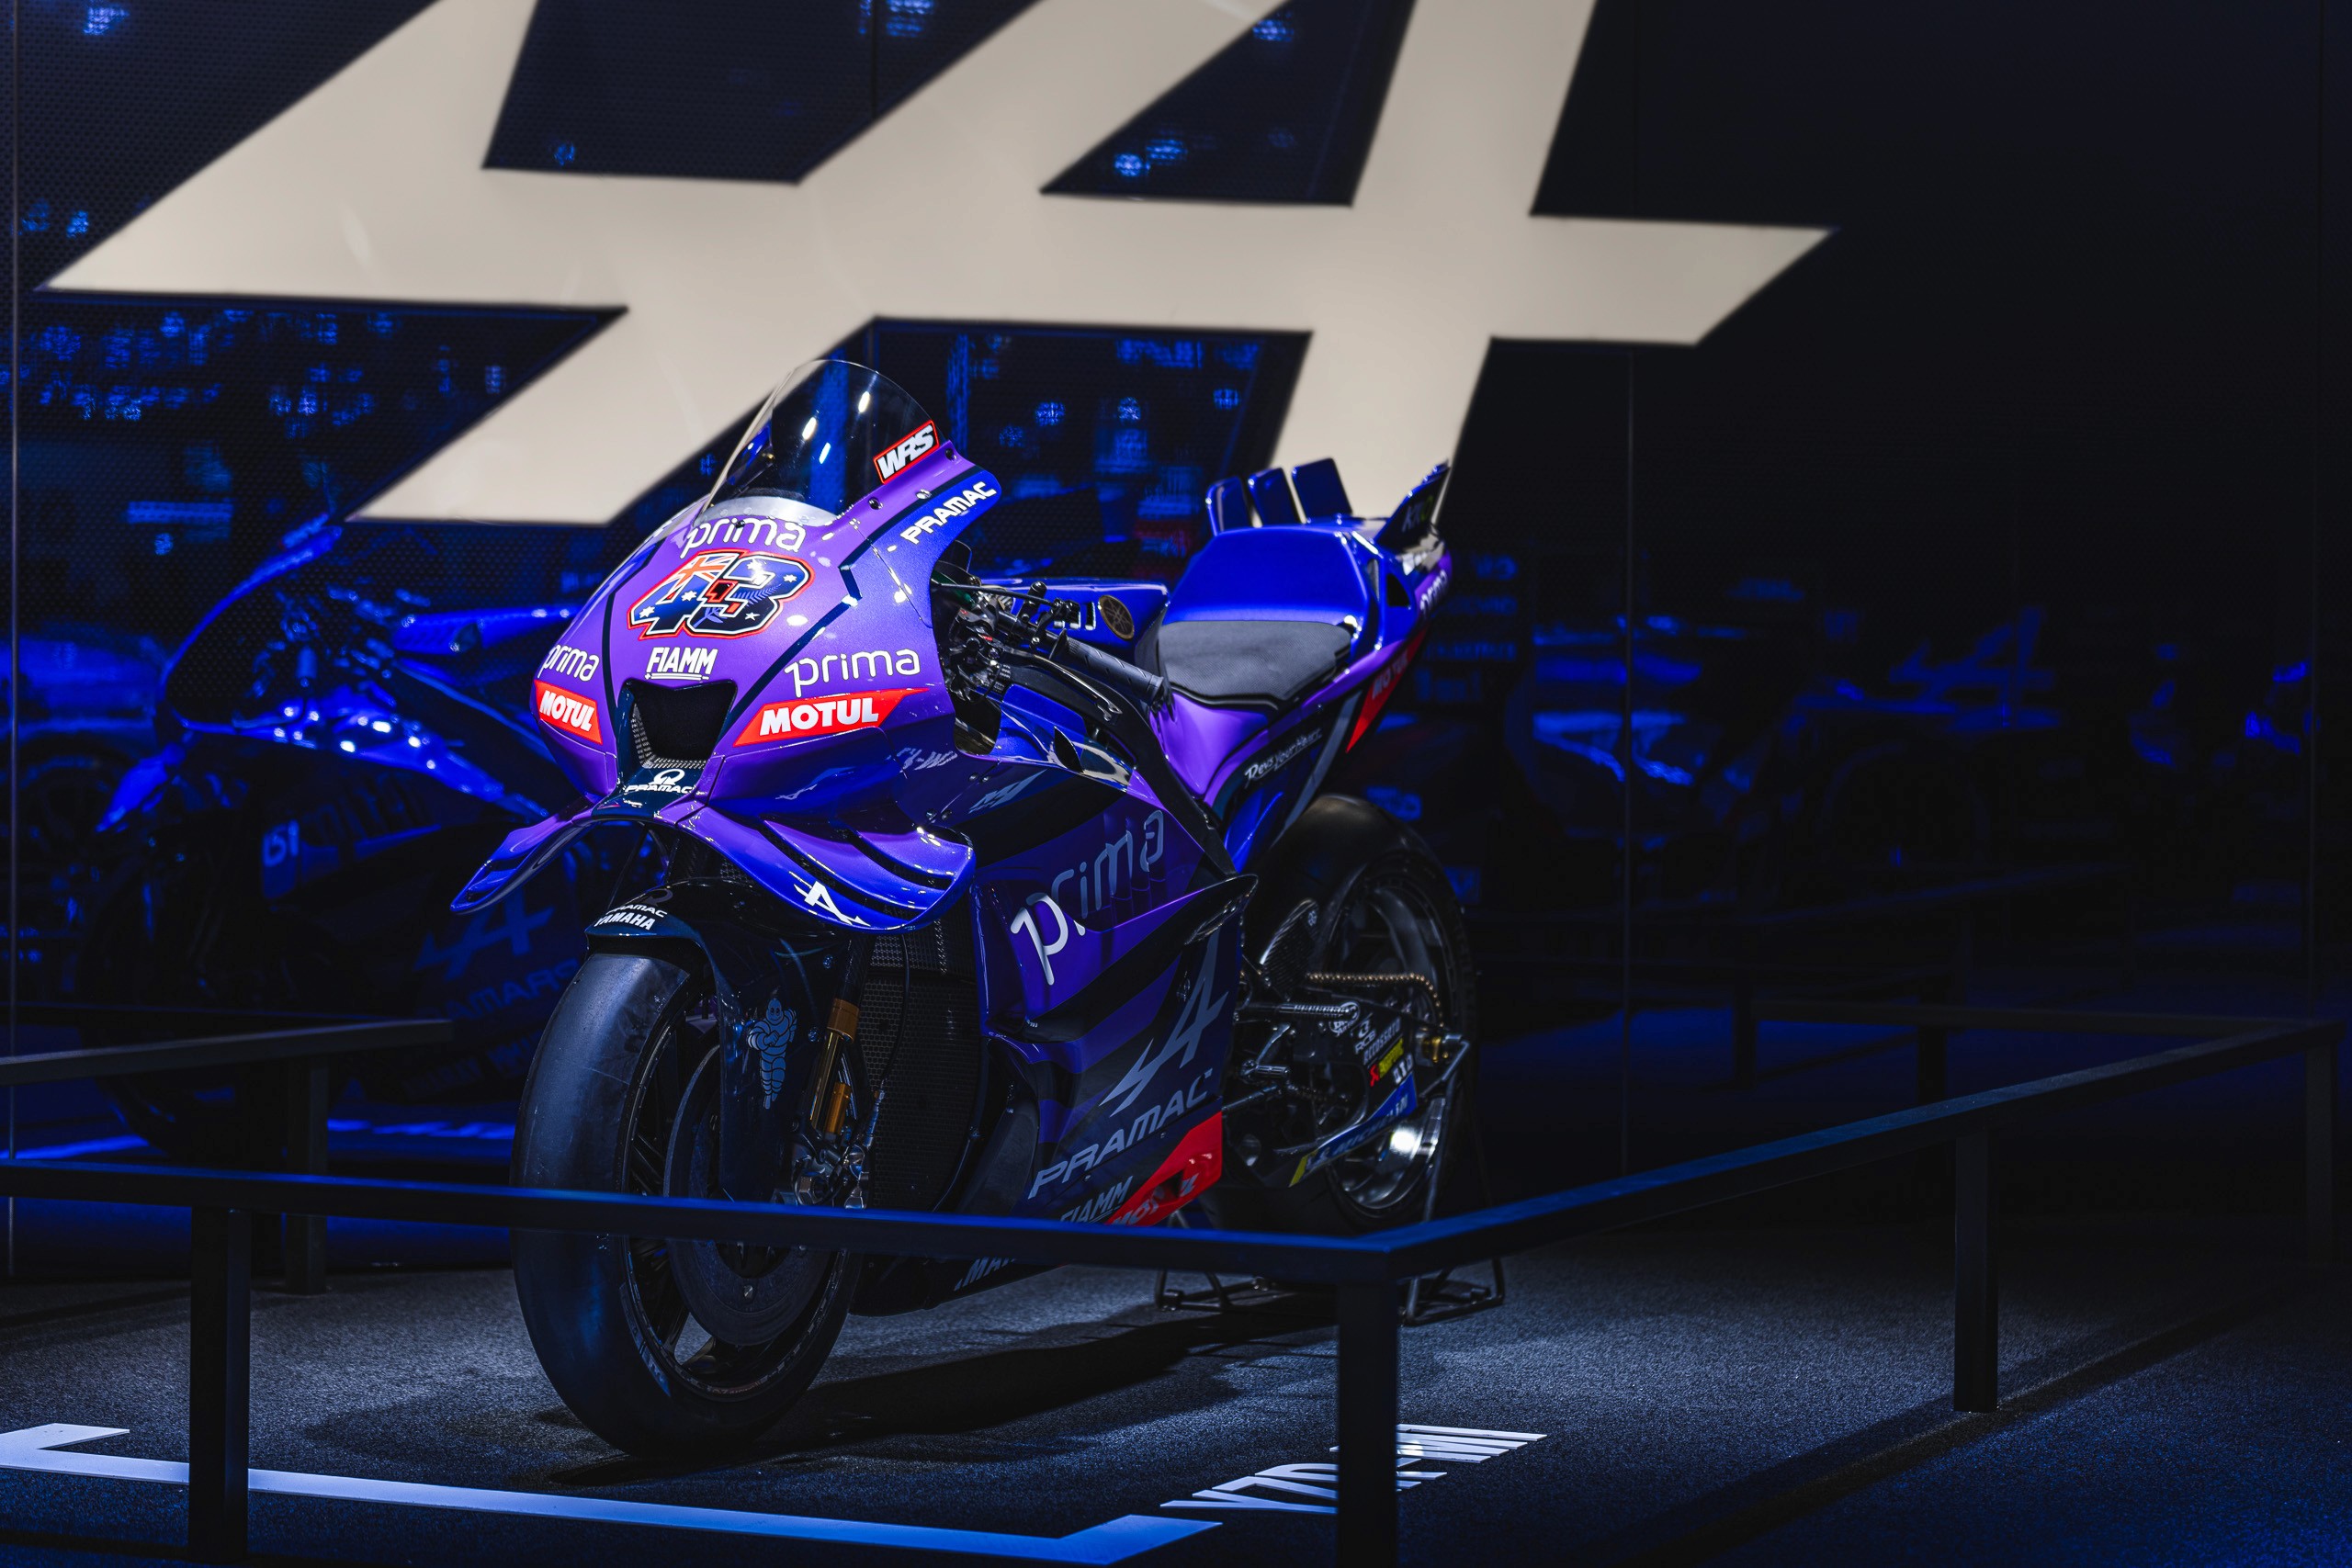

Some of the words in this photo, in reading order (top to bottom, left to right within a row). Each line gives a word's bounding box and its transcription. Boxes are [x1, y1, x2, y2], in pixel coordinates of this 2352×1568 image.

[877, 423, 939, 480] WRS
[900, 481, 997, 544] PRAMAC
[681, 518, 806, 558] prima
[628, 548, 816, 641] 43
[537, 644, 600, 682] prima
[646, 647, 718, 675] FIAMM
[785, 648, 921, 698] prima
[539, 690, 594, 732] MOTUL
[760, 697, 879, 737] MOTUL
[624, 784, 695, 795] PRAMAC
[1011, 810, 1165, 987] prima
[594, 911, 656, 931] YAMAHA
[1027, 1068, 1214, 1200] PRAMAC
